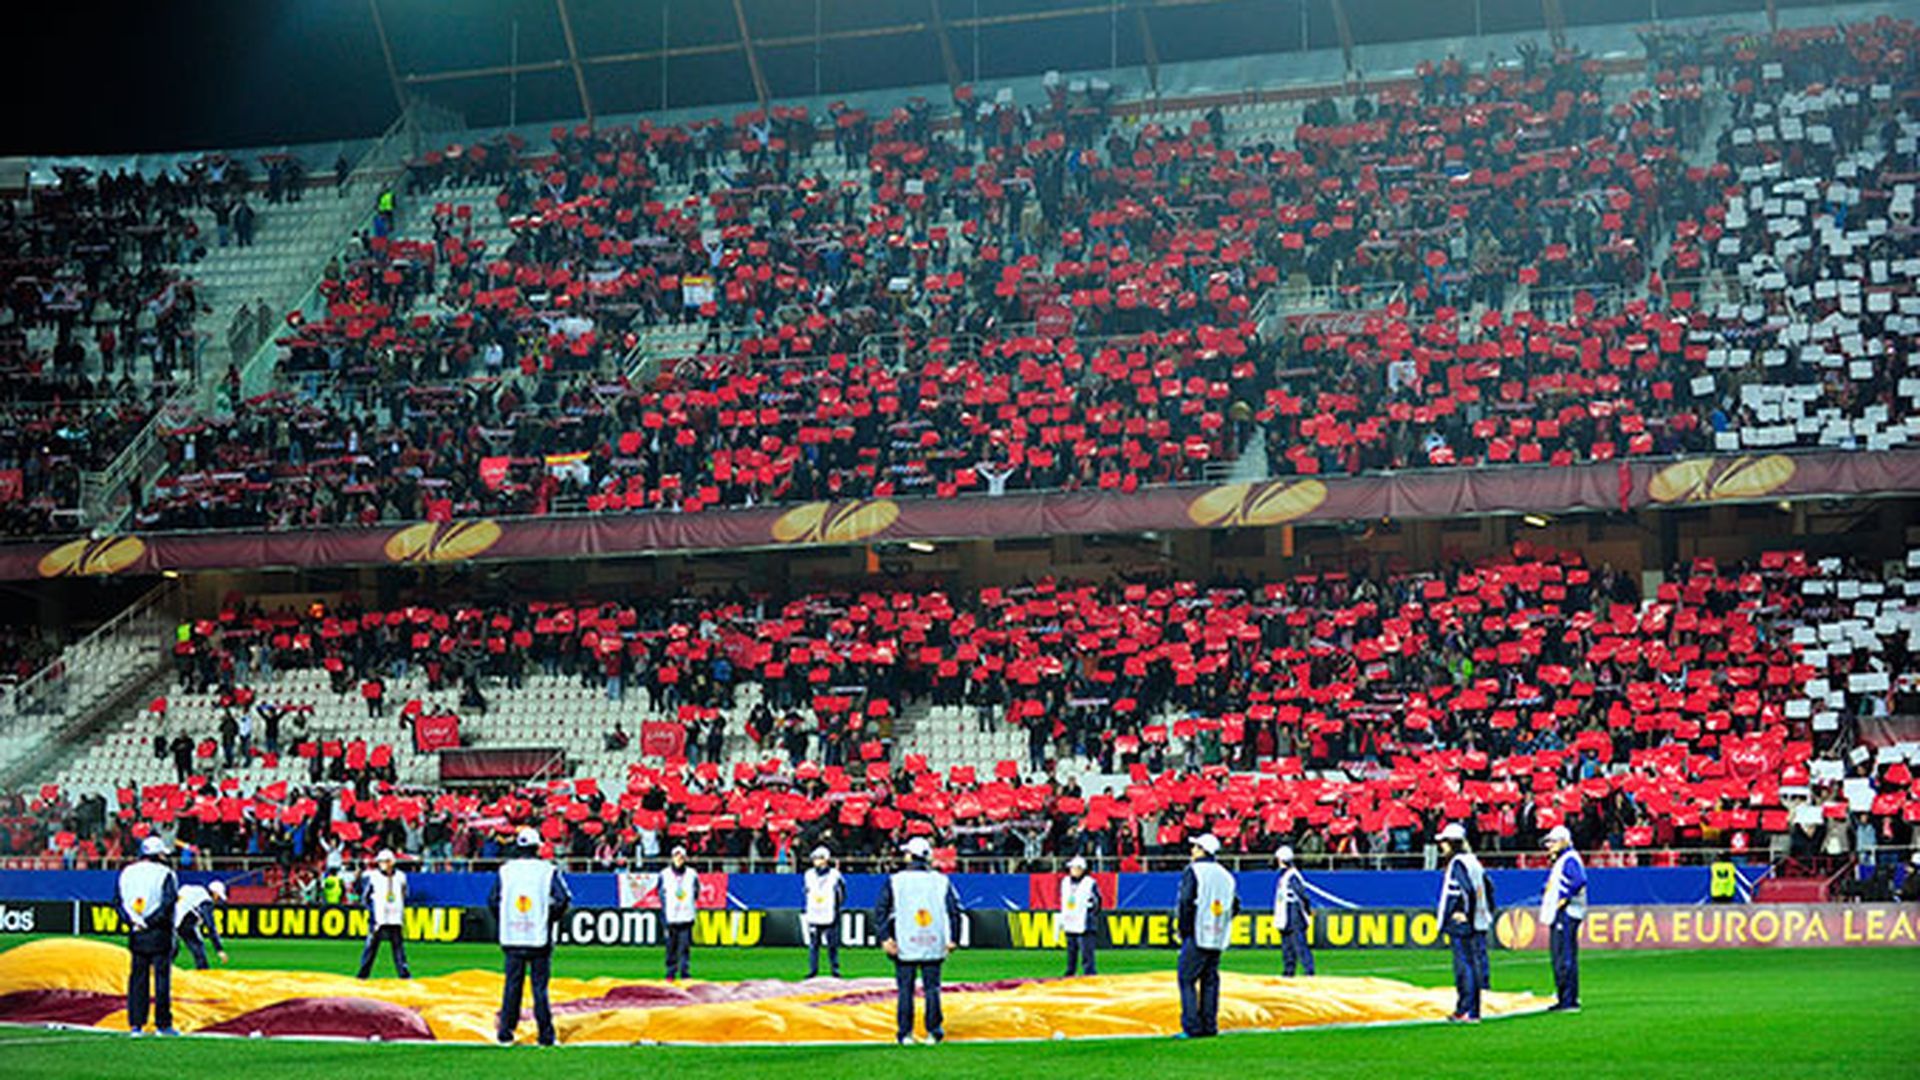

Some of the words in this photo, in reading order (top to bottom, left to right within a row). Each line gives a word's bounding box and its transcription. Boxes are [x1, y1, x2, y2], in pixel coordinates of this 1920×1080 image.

[258, 909, 370, 936] UNION
[405, 907, 461, 941] WU
[552, 911, 656, 942] .com
[700, 911, 761, 945] WU
[1018, 912, 1068, 947] W
[1326, 913, 1450, 946] UNIO
[1577, 912, 1660, 943] EFA
[1672, 910, 1830, 943] EUROPA
[1843, 910, 1920, 942] LEA
